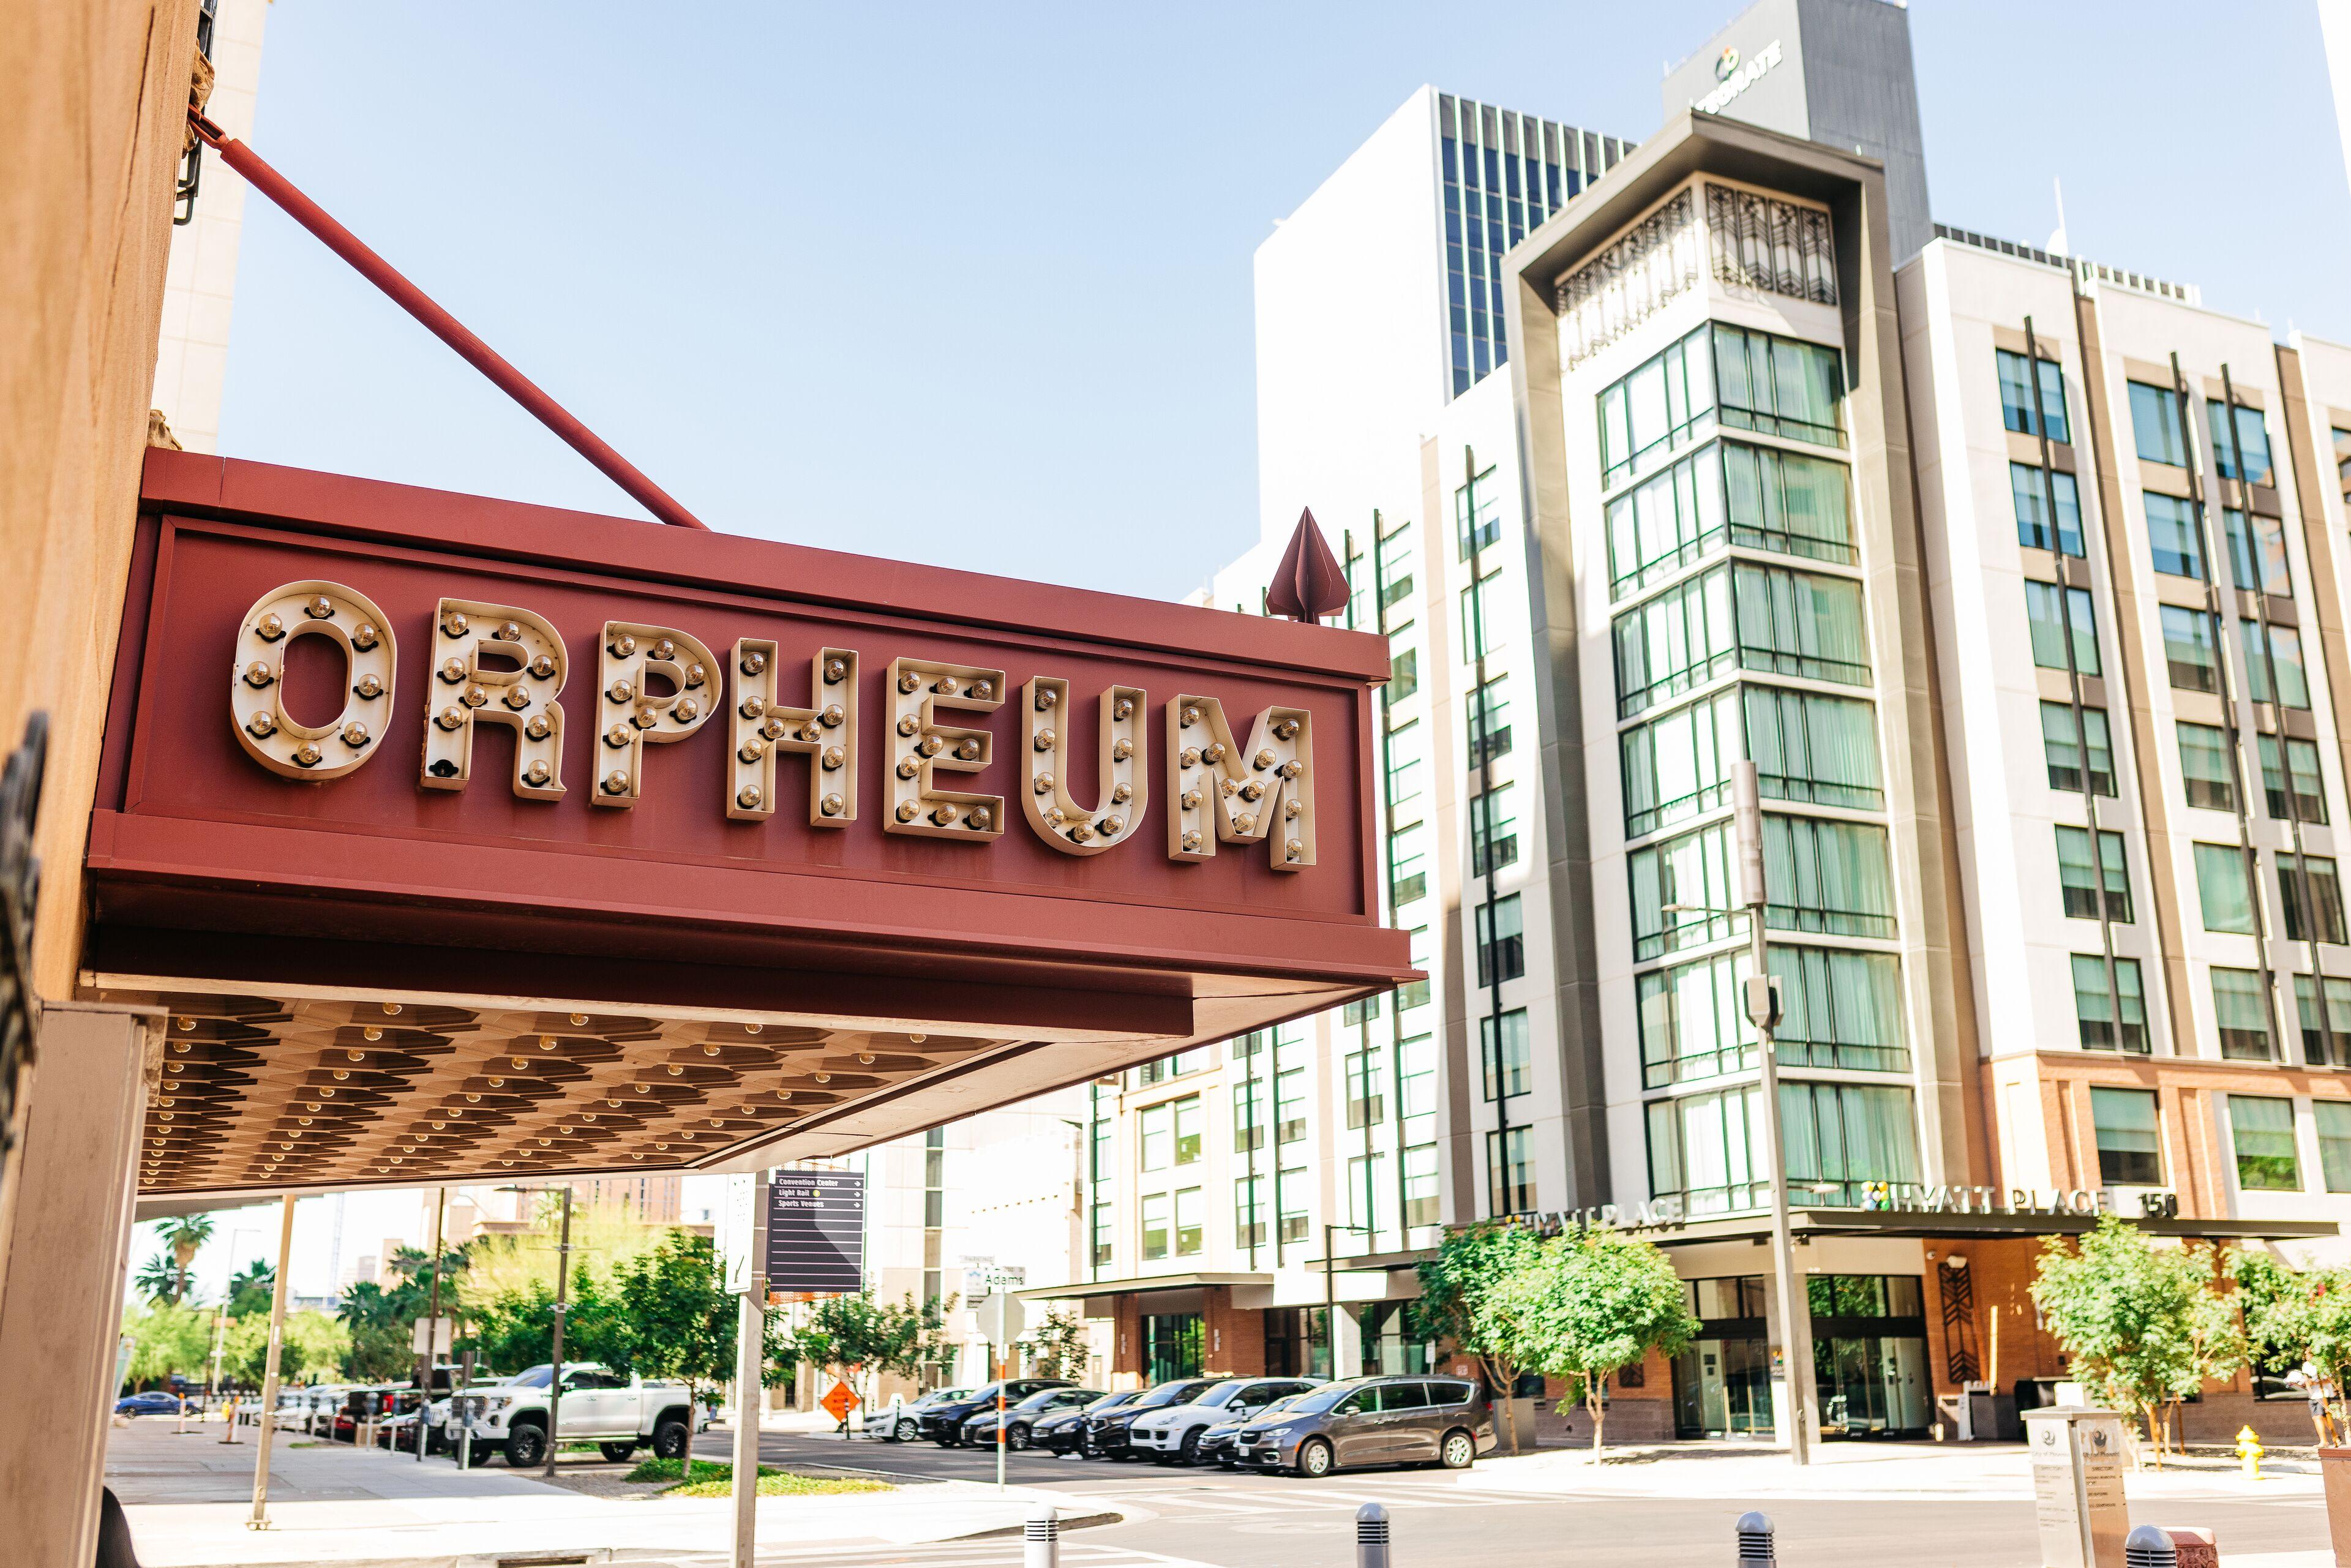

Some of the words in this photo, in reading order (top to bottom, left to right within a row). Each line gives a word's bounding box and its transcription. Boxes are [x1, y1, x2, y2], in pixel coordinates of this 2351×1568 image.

[231, 580, 1316, 871] ORPHEUM
[778, 1199, 799, 1208] Sports
[779, 1189, 795, 1198] Light
[1889, 1184, 1995, 1214] HYATT
[2006, 1188, 2108, 1217] PLACE
[1601, 1197, 1684, 1230] PLACE
[984, 1274, 1024, 1285] Adams
